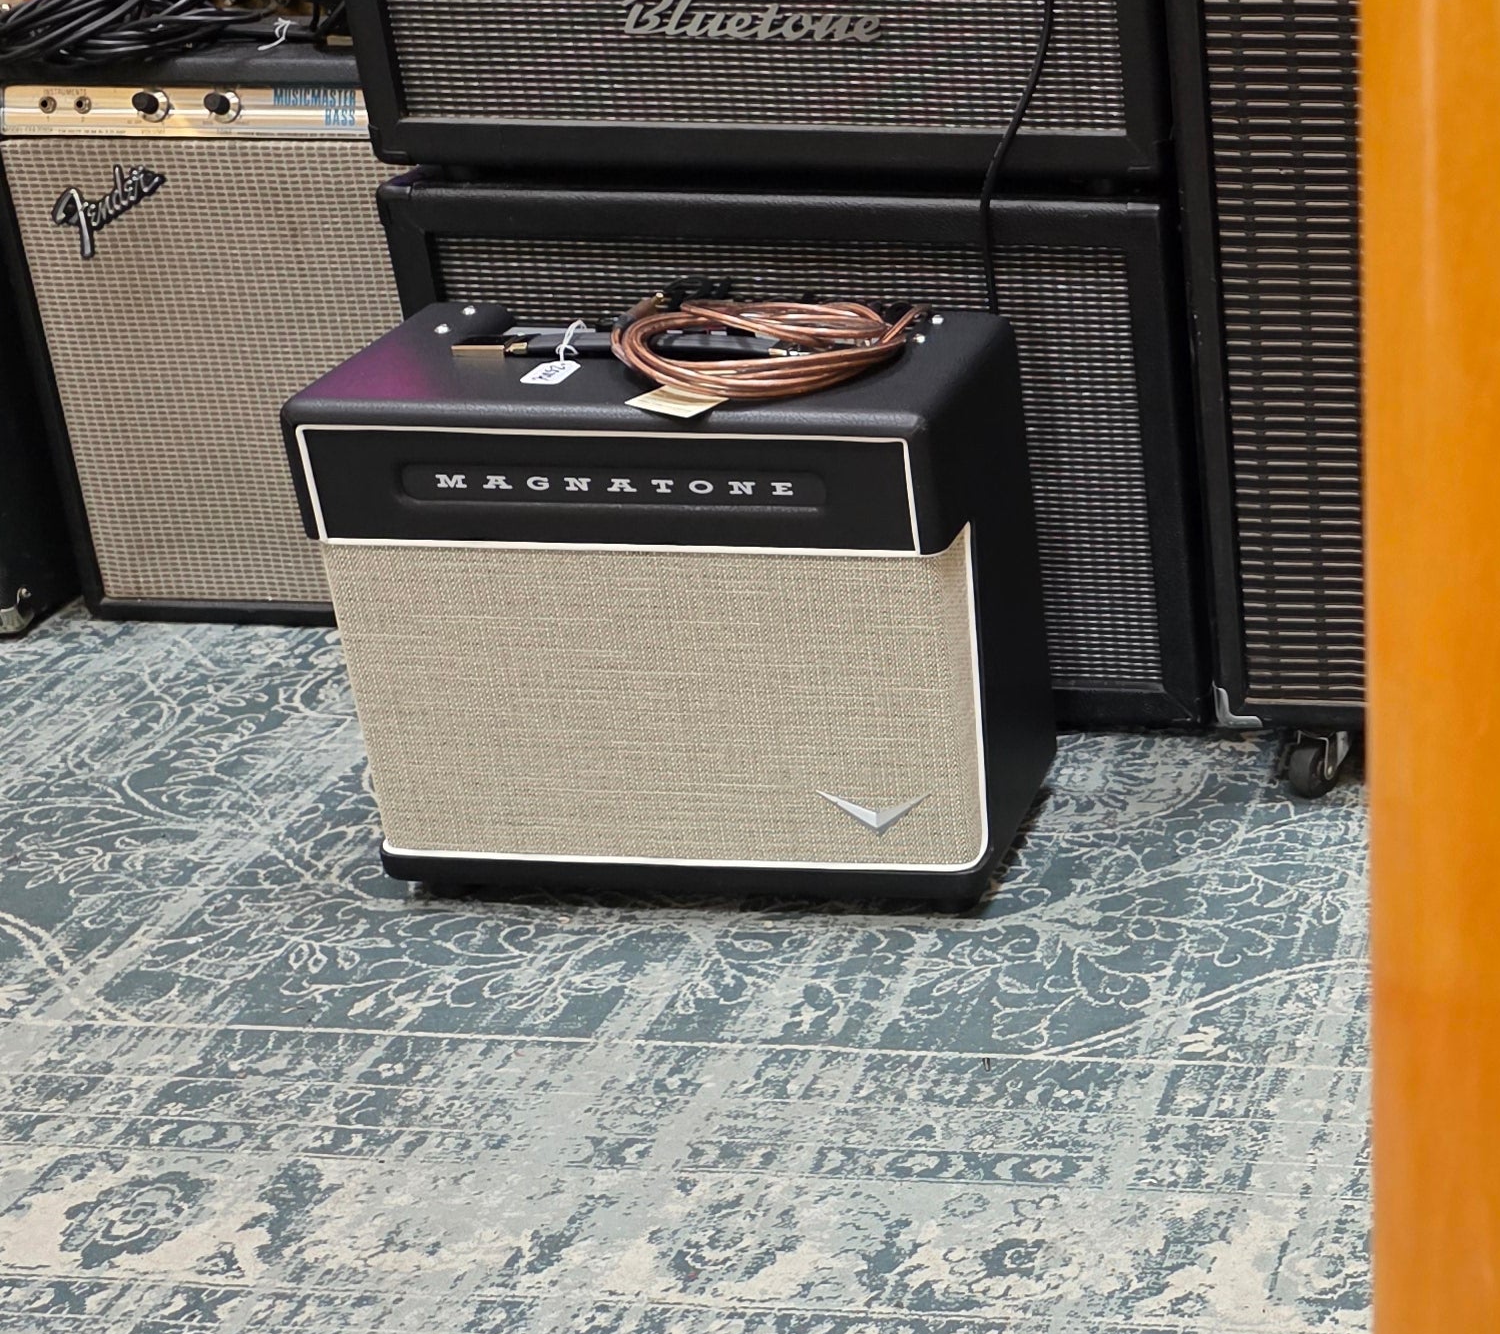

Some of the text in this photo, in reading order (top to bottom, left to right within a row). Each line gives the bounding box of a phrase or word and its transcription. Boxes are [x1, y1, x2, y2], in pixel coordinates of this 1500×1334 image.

[273, 87, 356, 107] MUSICMASTER
[324, 107, 355, 126] BASS
[52, 165, 166, 260] Fender
[435, 473, 794, 496] MAGNATONE
